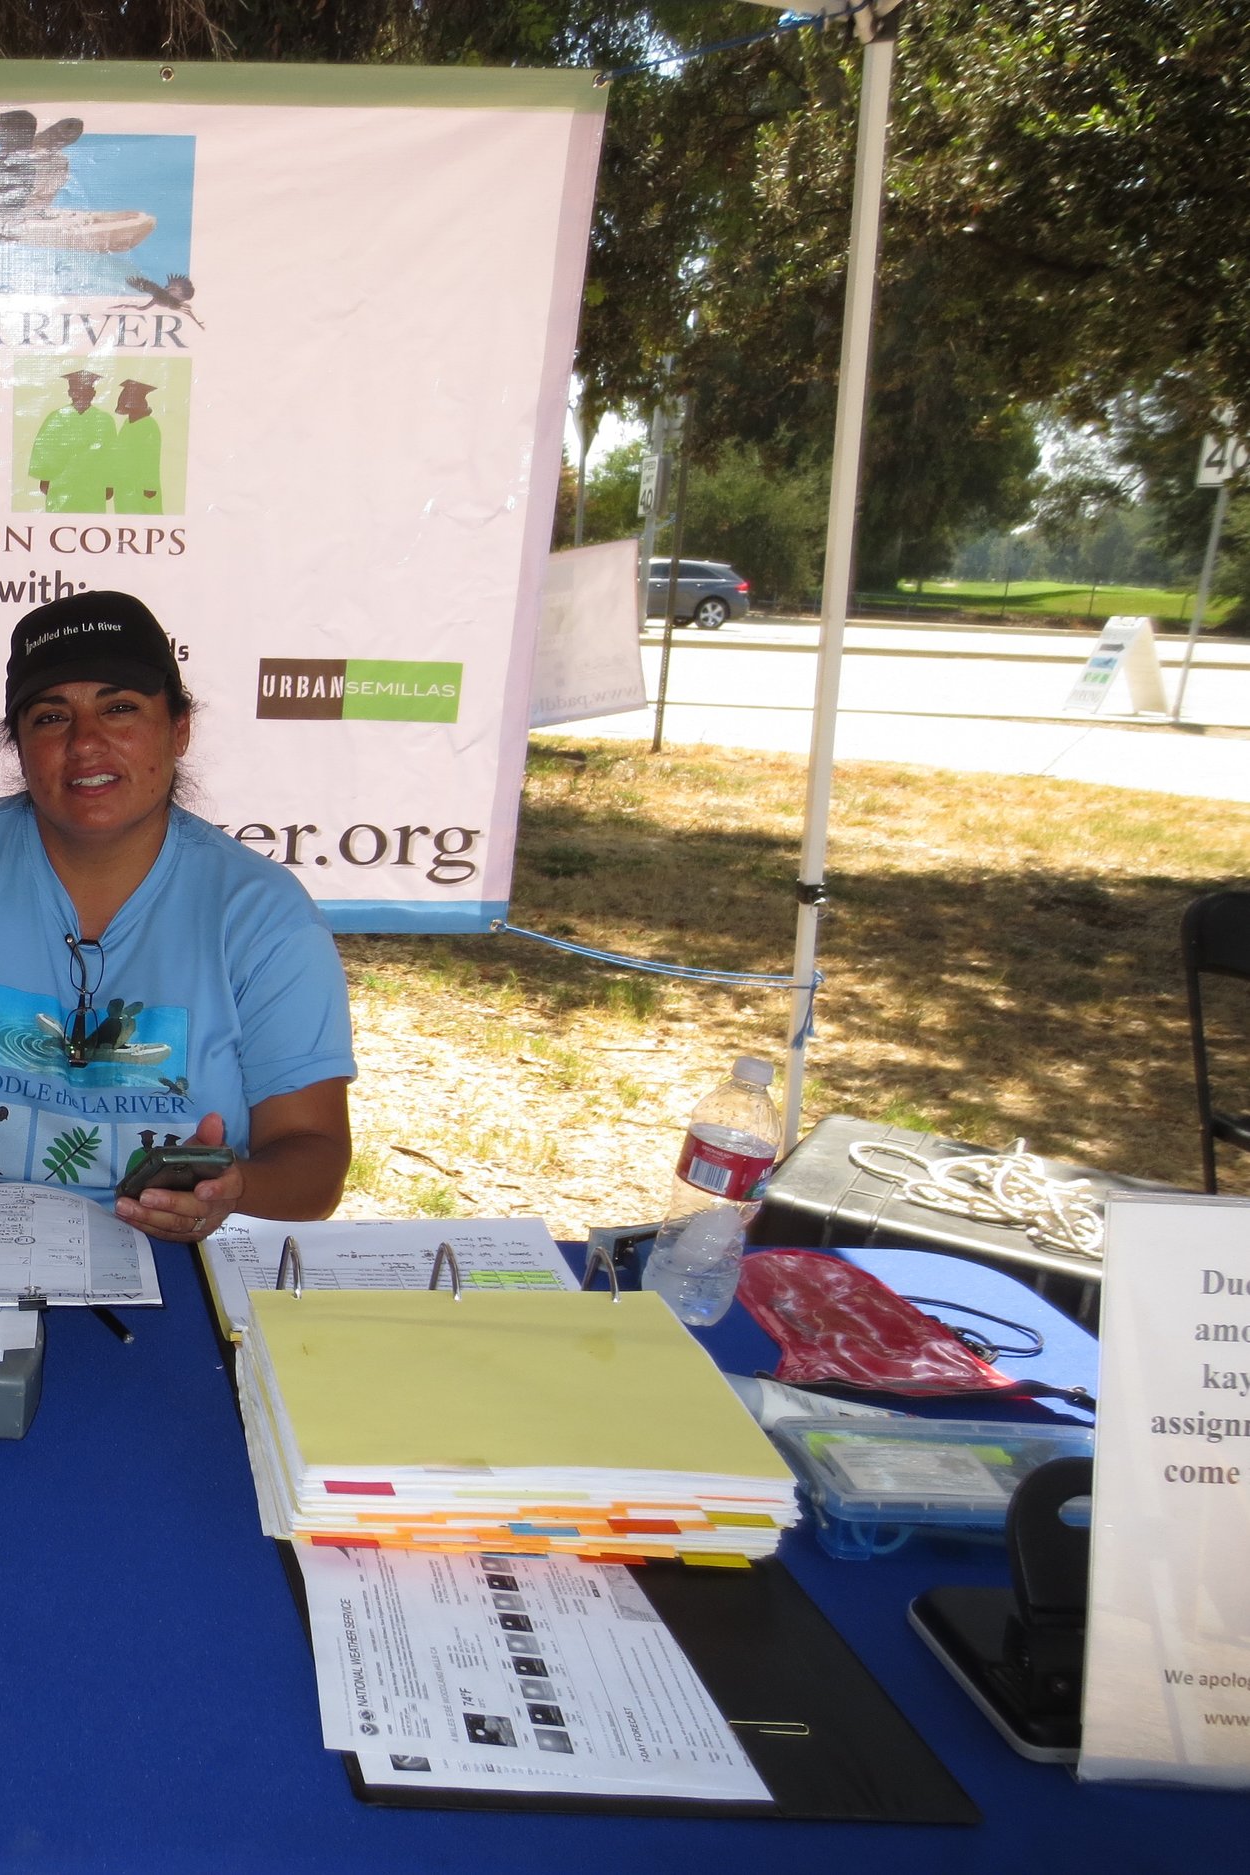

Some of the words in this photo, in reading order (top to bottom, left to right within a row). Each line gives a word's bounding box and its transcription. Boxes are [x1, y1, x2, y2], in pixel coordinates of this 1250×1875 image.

[8, 313, 190, 348] RIVER
[1205, 442, 1250, 475] 40
[640, 488, 653, 511] 40
[49, 526, 186, 556] CORPS
[63, 625, 79, 636] the
[82, 623, 95, 632] LA
[98, 621, 122, 632] River
[262, 674, 344, 699] URBAN
[345, 680, 456, 698] SEMILLAS
[56, 1089, 79, 1109] the
[82, 1096, 107, 1114] LA
[116, 1095, 188, 1114] RIVER
[1201, 1363, 1250, 1397] kay
[1164, 1464, 1240, 1484] come
[340, 1598, 356, 1629] SERVICE
[347, 1629, 362, 1666] WEATHER
[431, 1655, 445, 1671] HILLS
[1164, 1669, 1194, 1685] We
[352, 1667, 368, 1707] NATIONAL
[623, 1706, 644, 1742] FORECAST
